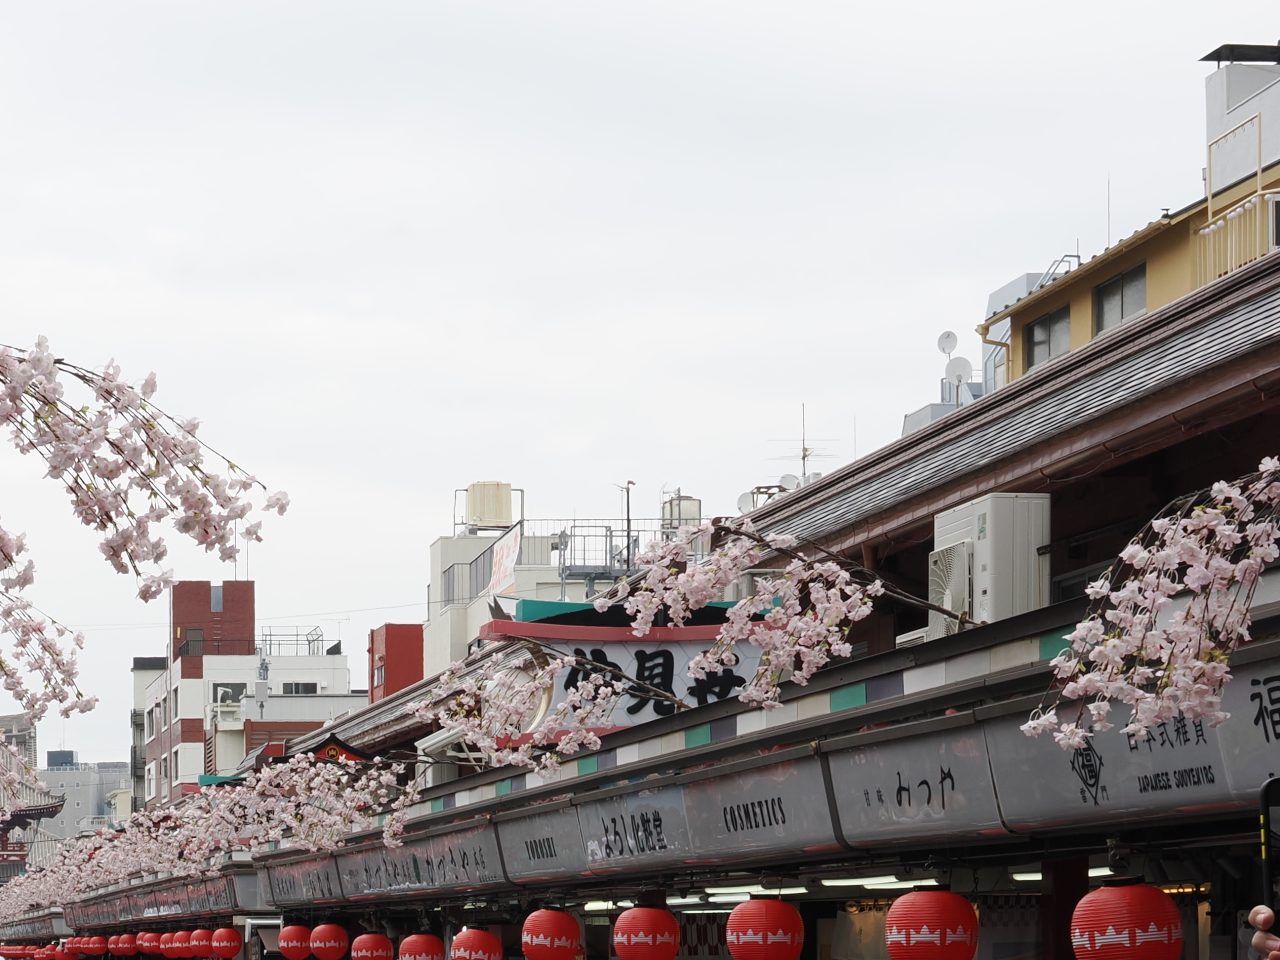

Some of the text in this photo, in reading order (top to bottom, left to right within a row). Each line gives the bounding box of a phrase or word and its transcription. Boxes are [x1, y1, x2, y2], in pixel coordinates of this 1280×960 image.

[896, 765, 955, 810] みつや
[1137, 765, 1215, 794] JAPANESE SOUVENIRS
[601, 809, 668, 860] よろし化粧堂
[722, 797, 786, 833] COSMETICS
